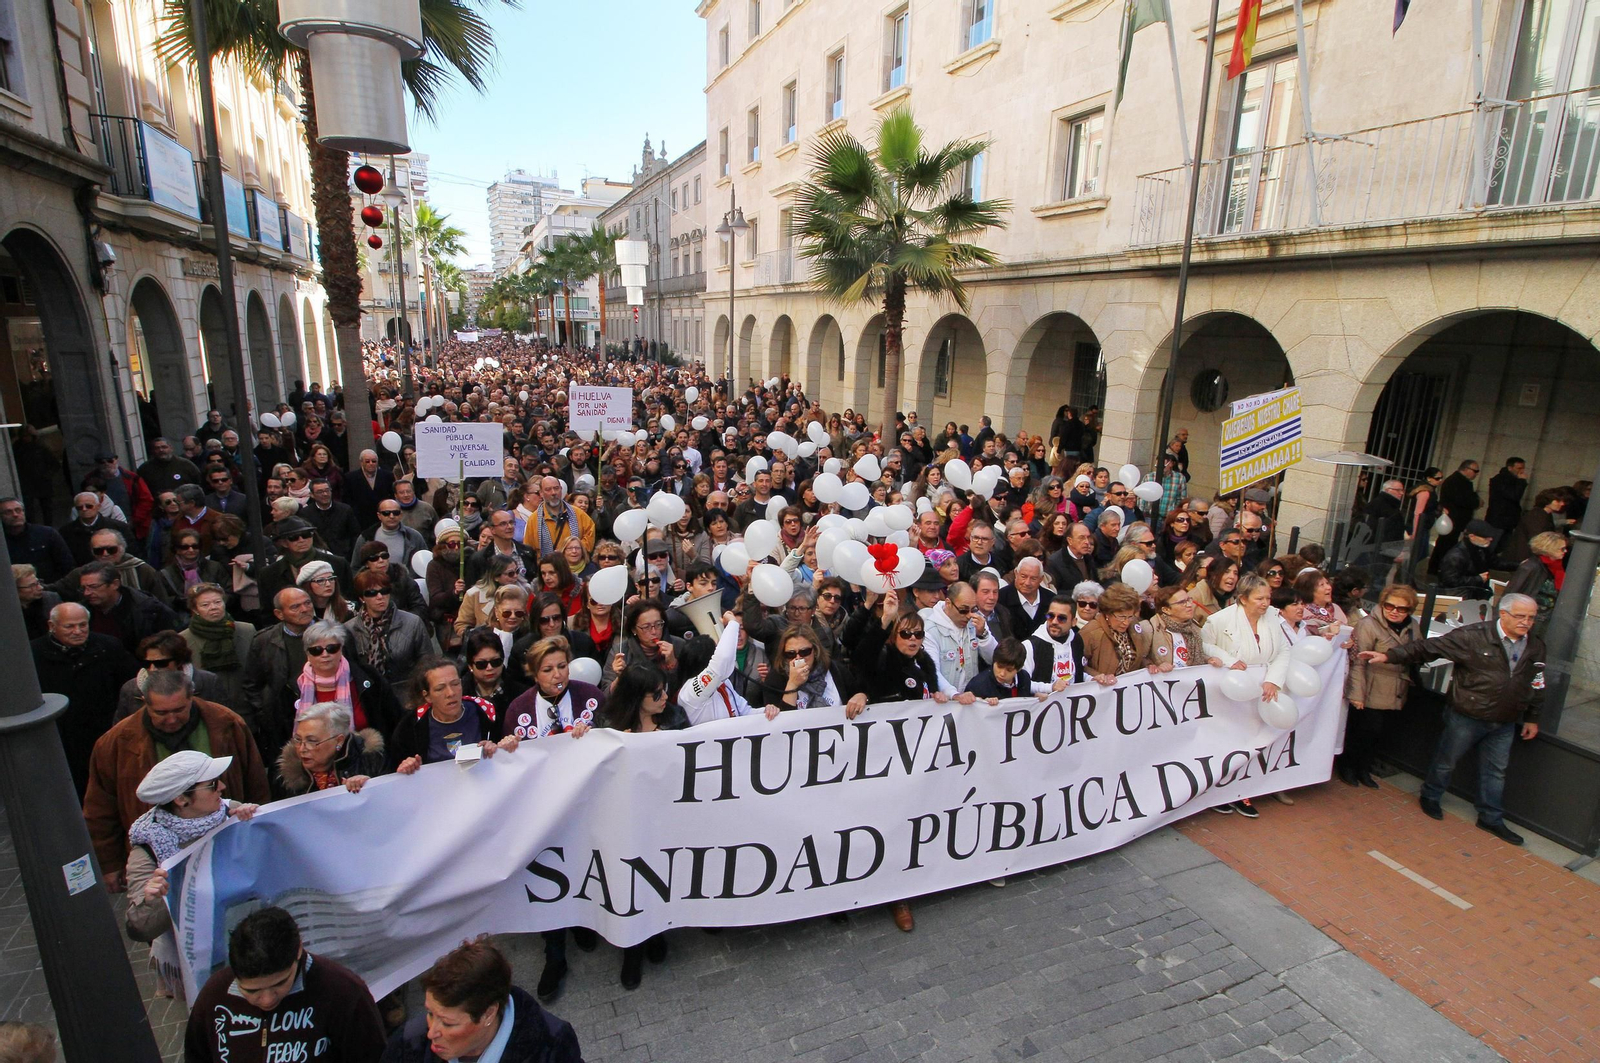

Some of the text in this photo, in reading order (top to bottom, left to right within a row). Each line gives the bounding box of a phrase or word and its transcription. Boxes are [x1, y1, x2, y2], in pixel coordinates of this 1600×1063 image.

[578, 391, 612, 401] HUELVA
[1257, 402, 1280, 428] NUESTRO
[422, 425, 457, 434] SANIDAD
[445, 433, 474, 441] PÚBLICA
[450, 443, 490, 452] UNIVERSAL
[464, 459, 496, 467] CALIDAD
[673, 678, 1213, 804] HUELVA, POR UNA
[524, 825, 885, 918] SANIDAD
[902, 770, 1147, 872] PÚBLICA
